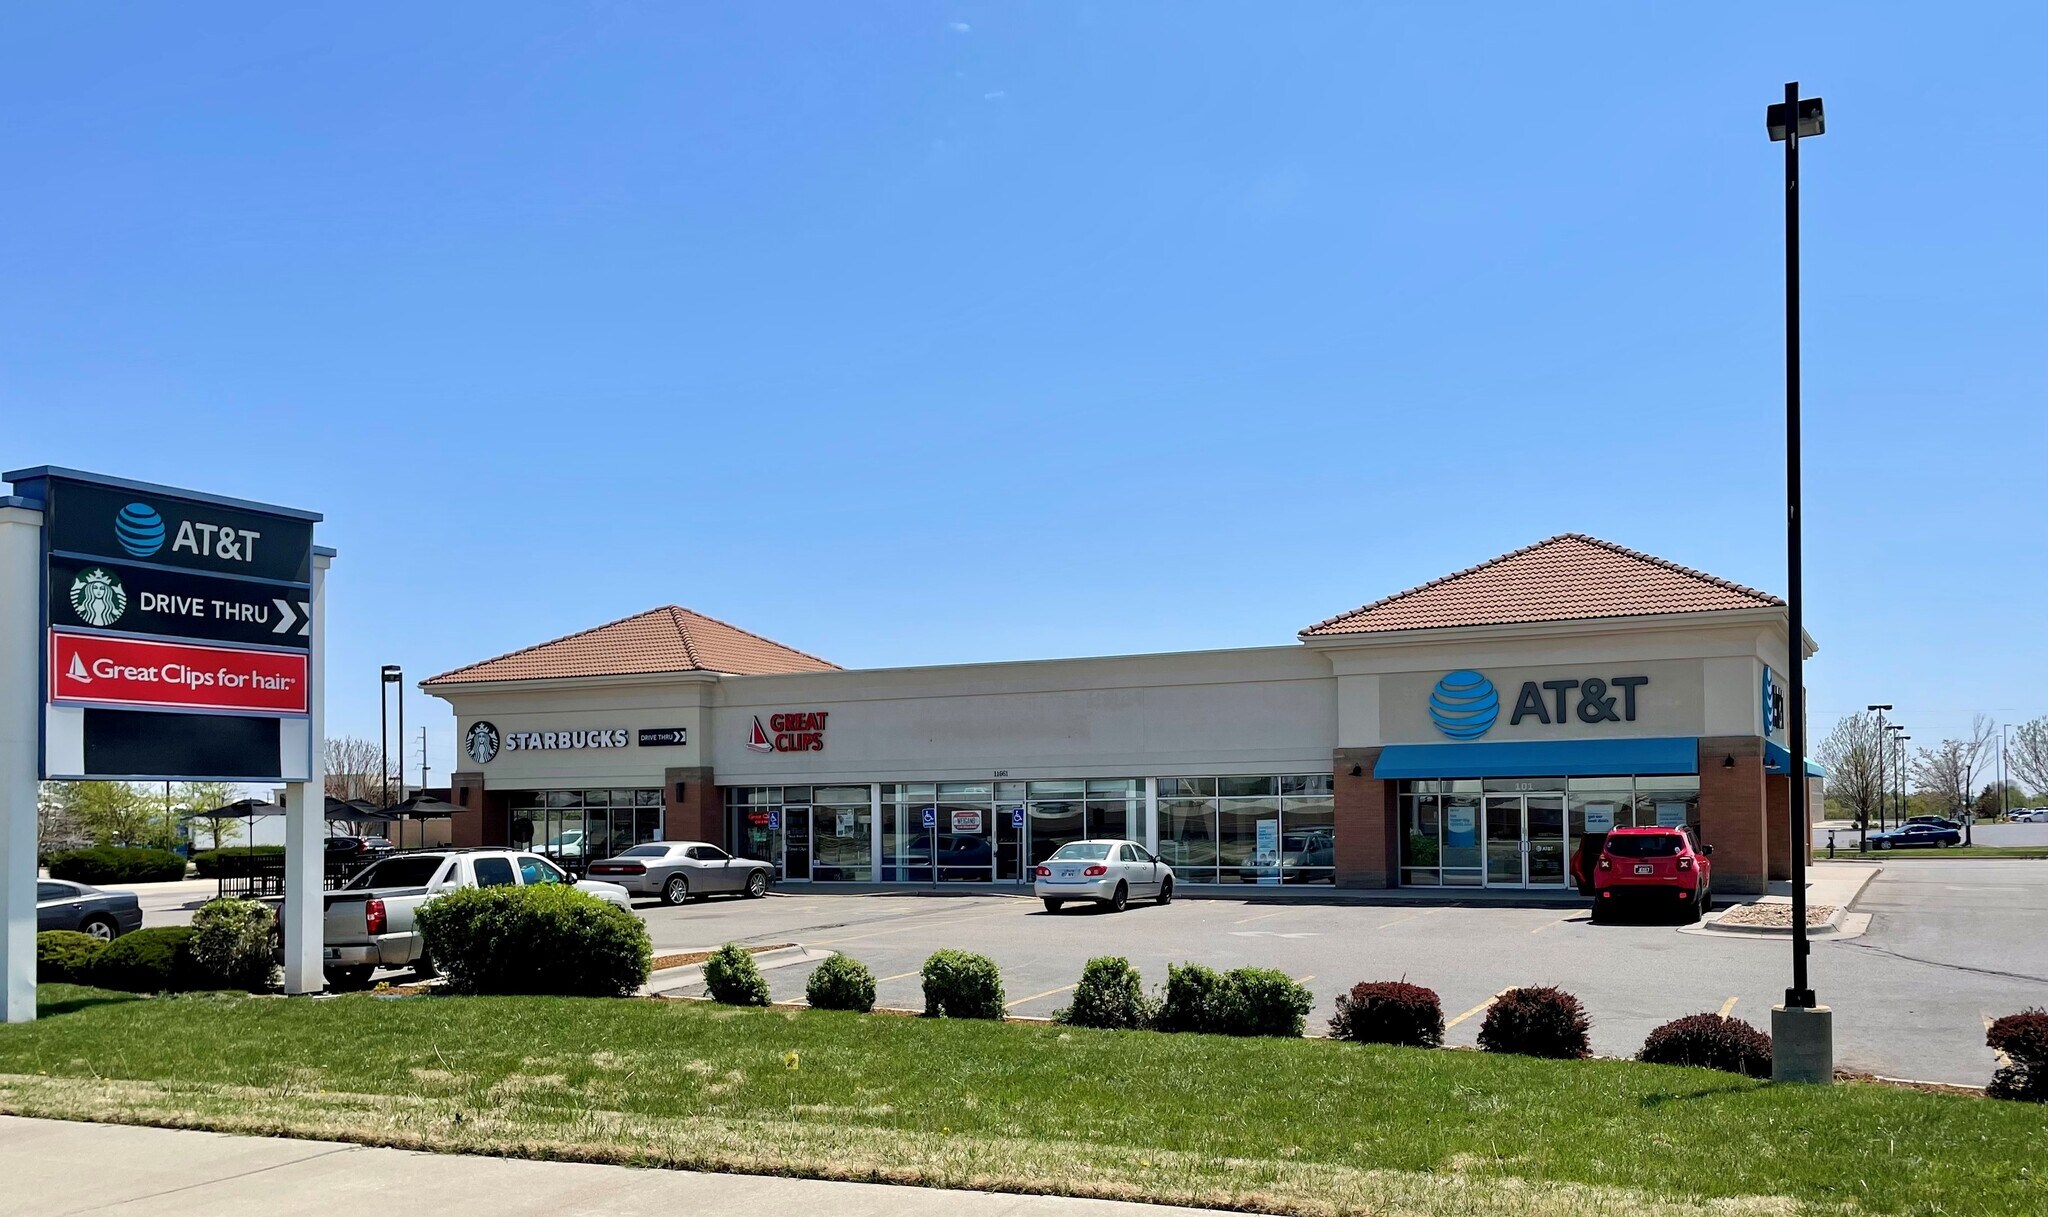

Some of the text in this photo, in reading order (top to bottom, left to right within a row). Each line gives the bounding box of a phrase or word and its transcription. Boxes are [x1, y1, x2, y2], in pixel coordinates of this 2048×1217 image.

[172, 520, 260, 562] AT&T
[140, 592, 268, 623] DRIVE THRU
[92, 658, 158, 682] Great
[161, 664, 214, 690] Clips
[217, 668, 249, 688] for
[1510, 676, 1649, 725] AT&T
[770, 712, 828, 732] GREAT
[505, 729, 629, 751] STARBUCKS
[658, 733, 673, 741] THRU
[775, 732, 823, 752] CLIPS
[1515, 782, 1534, 791] 101
